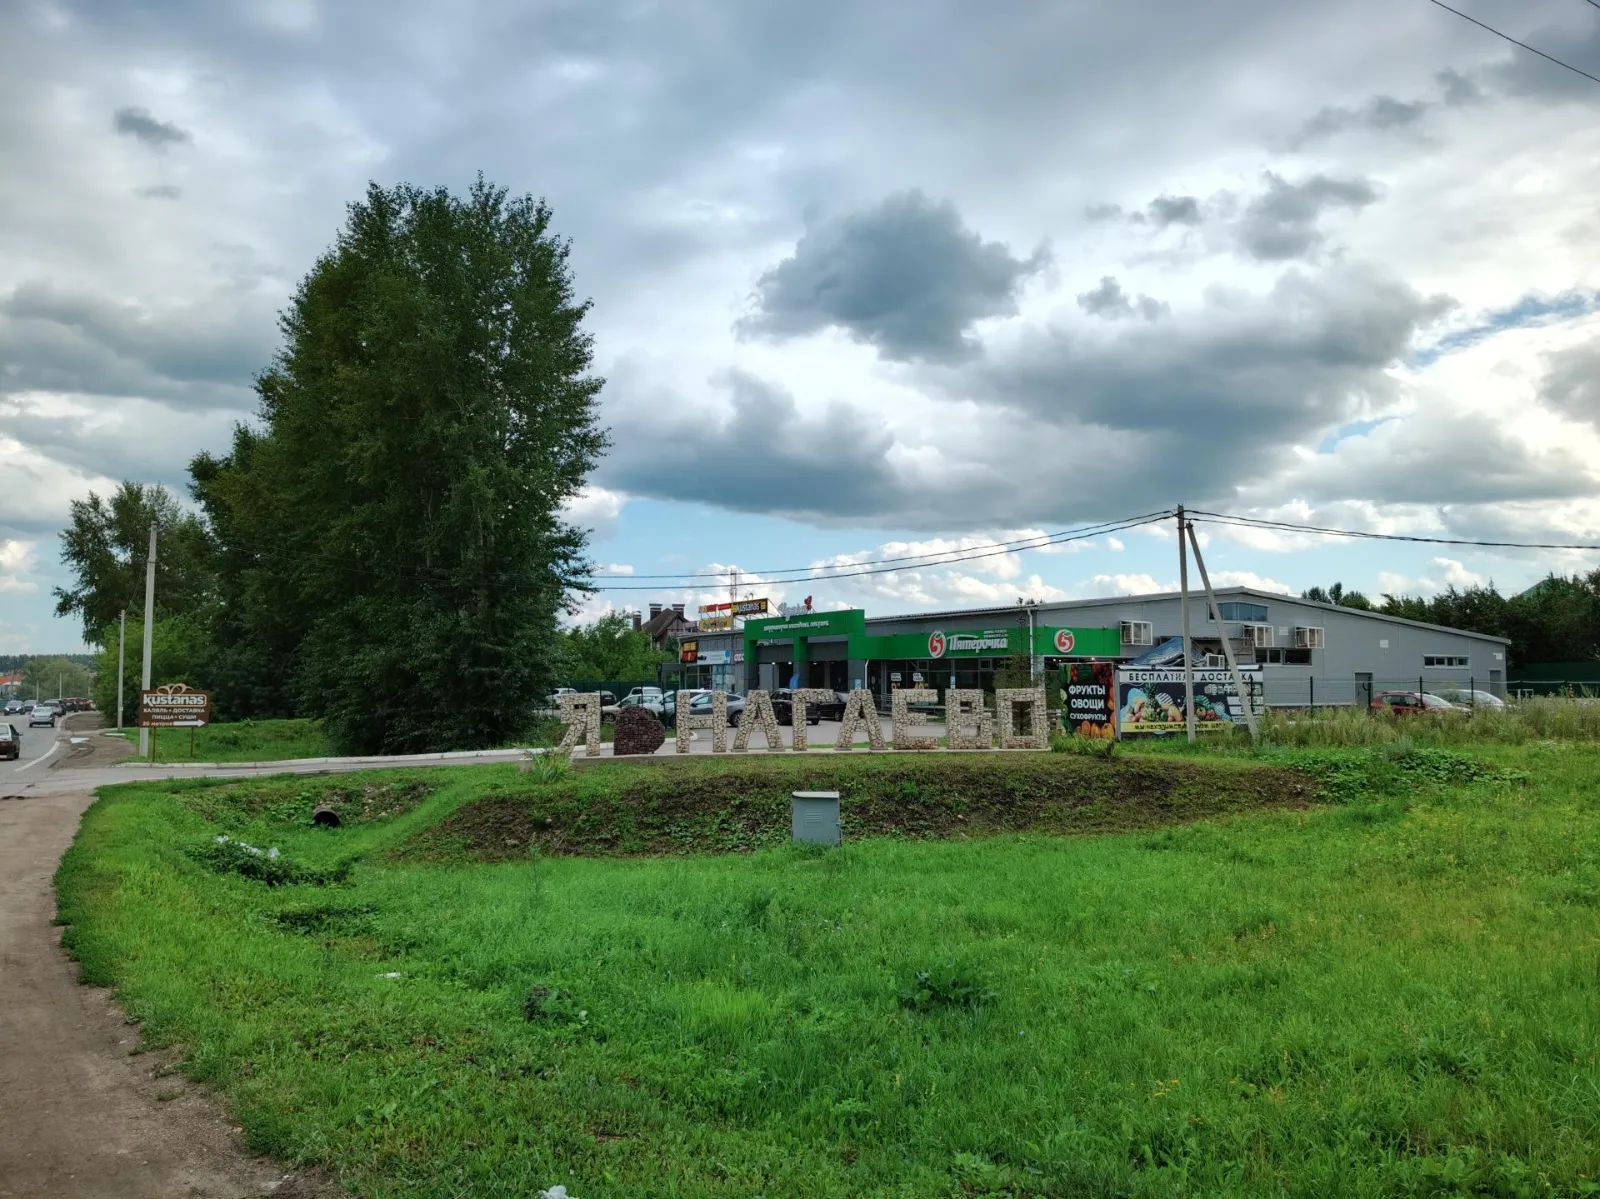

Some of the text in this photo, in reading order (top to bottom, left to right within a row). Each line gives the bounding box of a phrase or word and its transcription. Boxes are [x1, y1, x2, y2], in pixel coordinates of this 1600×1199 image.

[1200, 673, 1253, 681] ДОСТАКА
[1068, 685, 1106, 695] ФРУКТЫ
[143, 694, 204, 707] kustanas
[1070, 698, 1105, 710] ОВОЩИ
[676, 688, 1050, 754] НАГАЕВО
[1069, 713, 1107, 721] СУХОФРУКТЫ
